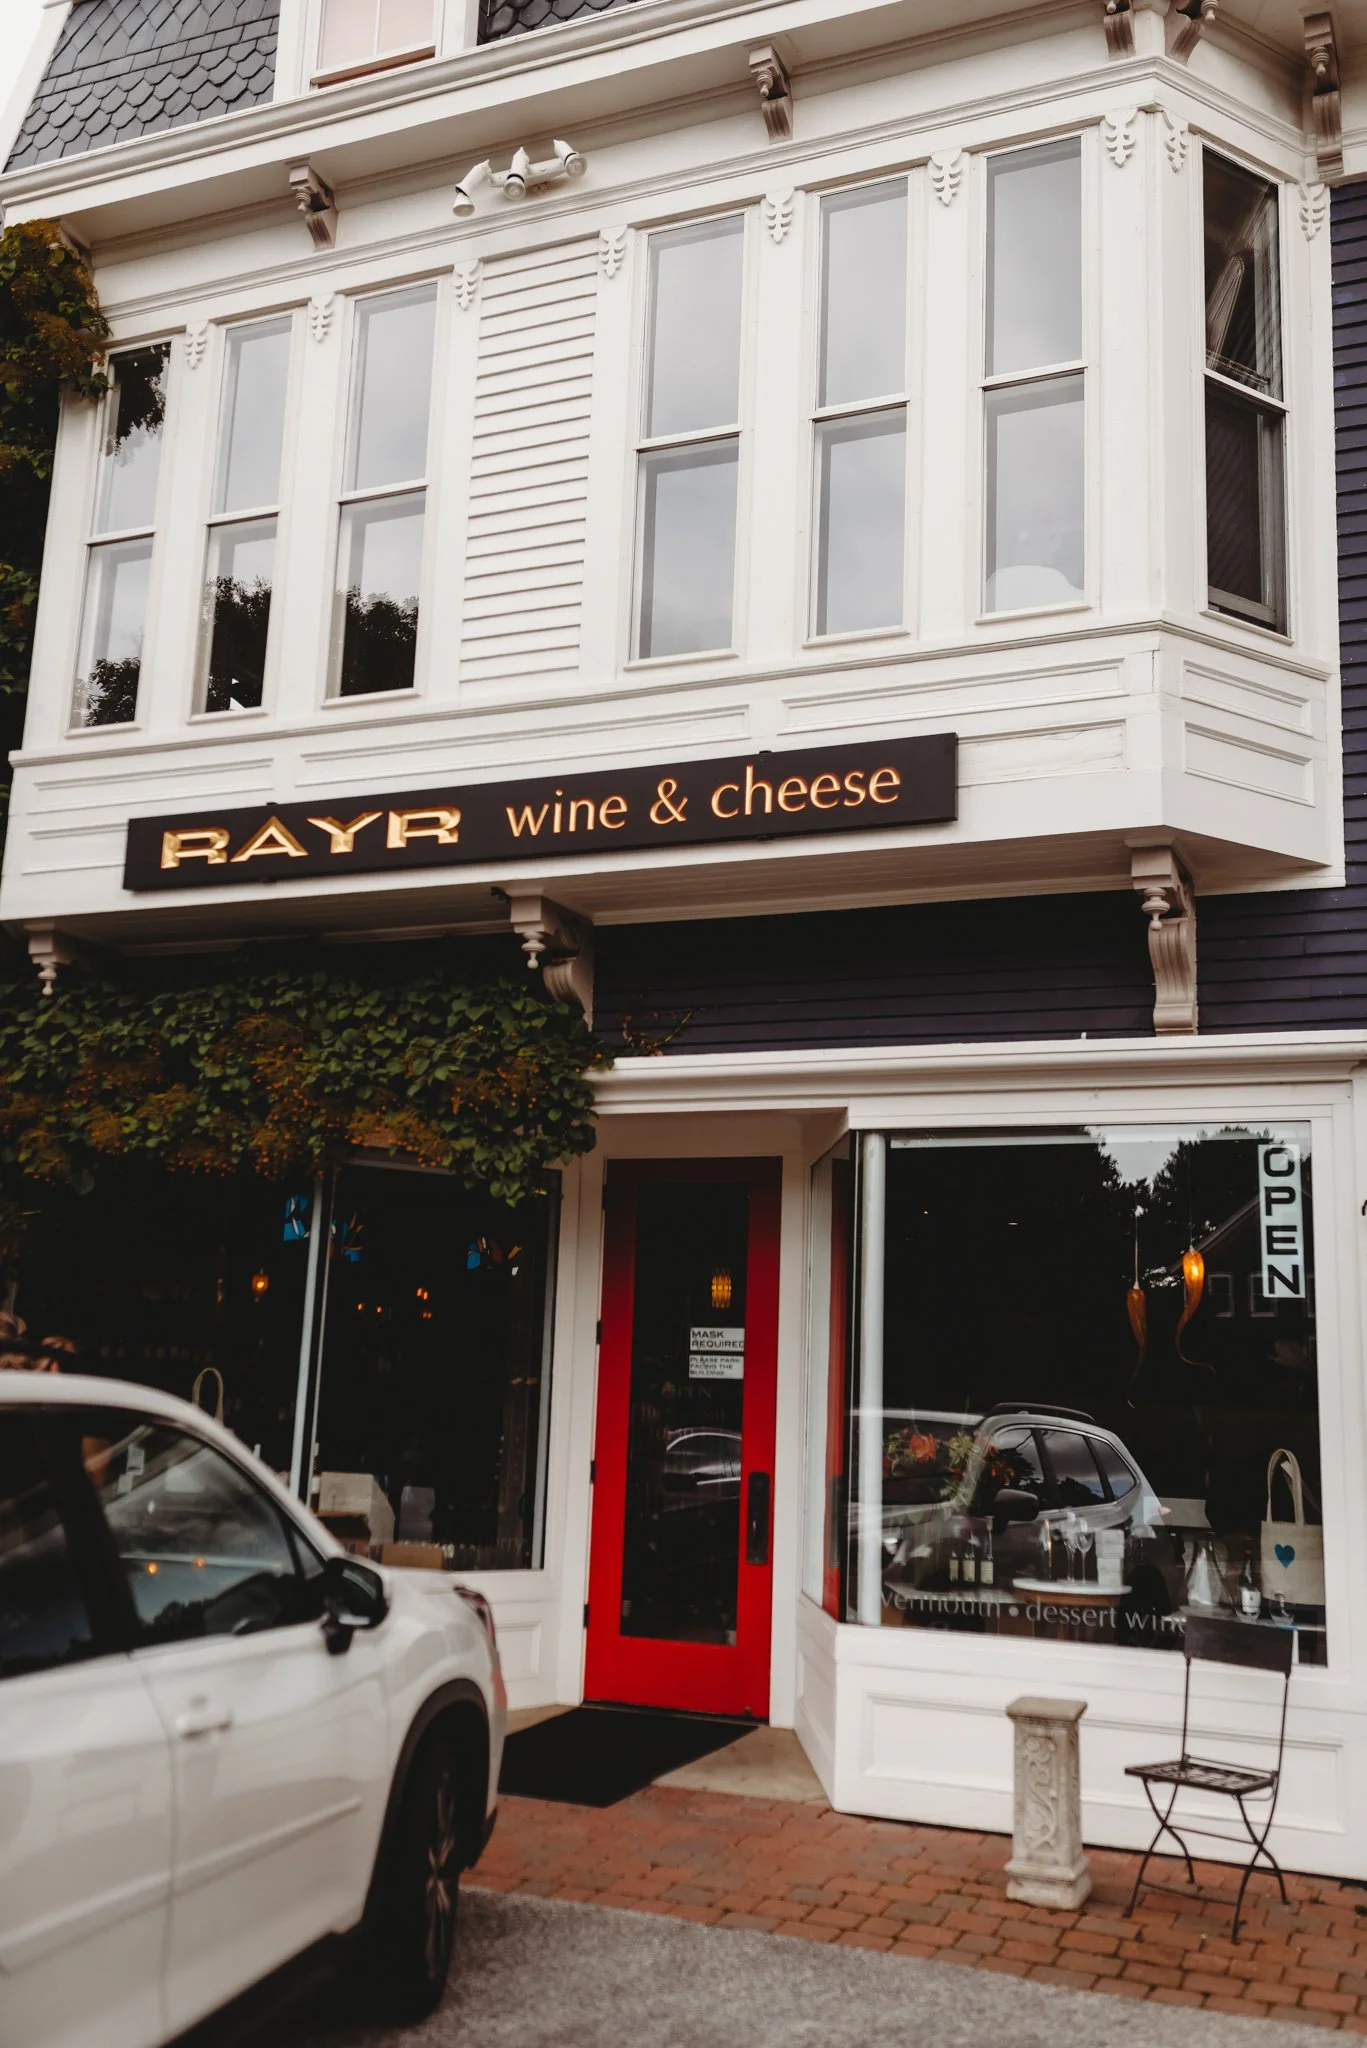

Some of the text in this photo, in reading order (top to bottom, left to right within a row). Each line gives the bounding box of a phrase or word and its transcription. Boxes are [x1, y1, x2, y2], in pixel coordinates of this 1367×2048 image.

[160, 764, 901, 869] RAYR wine & cheese
[1263, 1147, 1300, 1296] OPEN
[691, 1330, 725, 1339] MASK
[691, 1340, 745, 1349] REQUIRED
[1026, 1600, 1118, 1629] dessert
